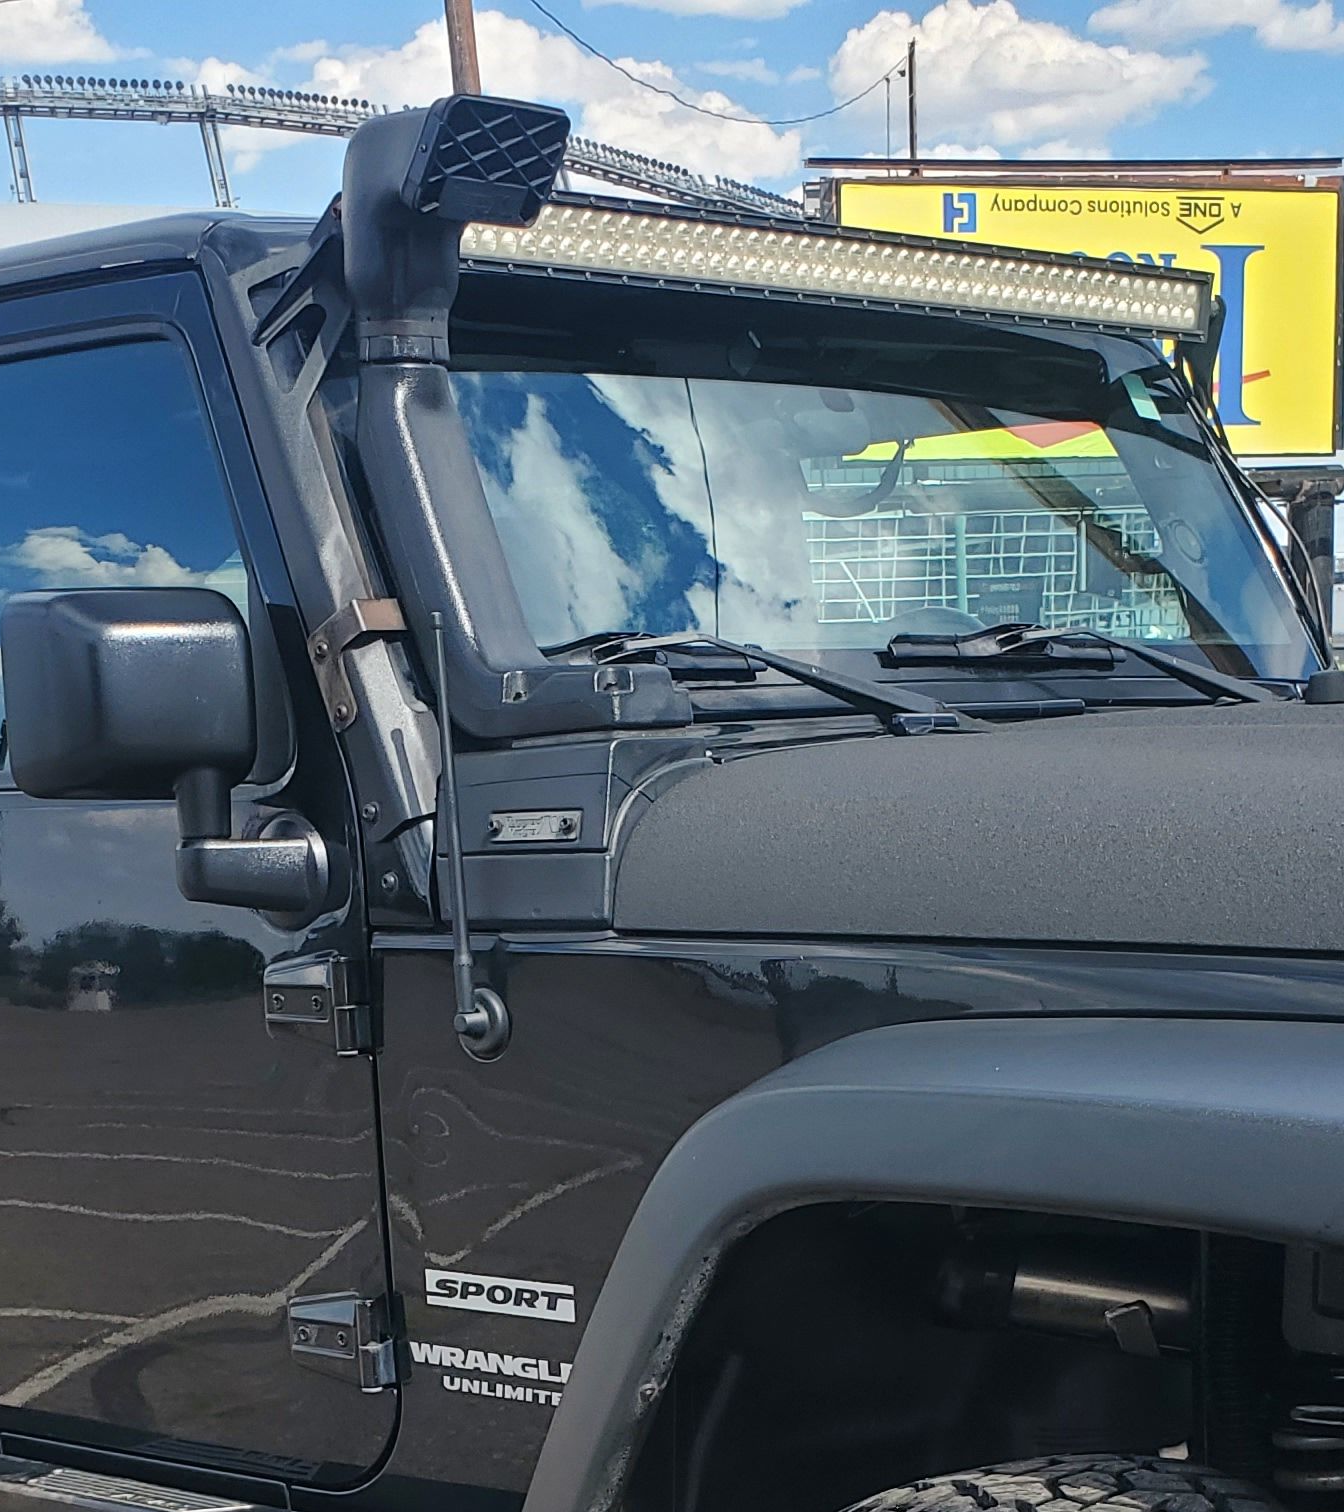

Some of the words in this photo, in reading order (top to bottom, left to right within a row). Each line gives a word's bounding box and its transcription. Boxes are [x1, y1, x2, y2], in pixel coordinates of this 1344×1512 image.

[990, 194, 1082, 215] Company
[1088, 200, 1170, 218] Solutions
[1178, 202, 1222, 218] ONE
[1231, 202, 1243, 218] A
[433, 1278, 574, 1312] SPORT
